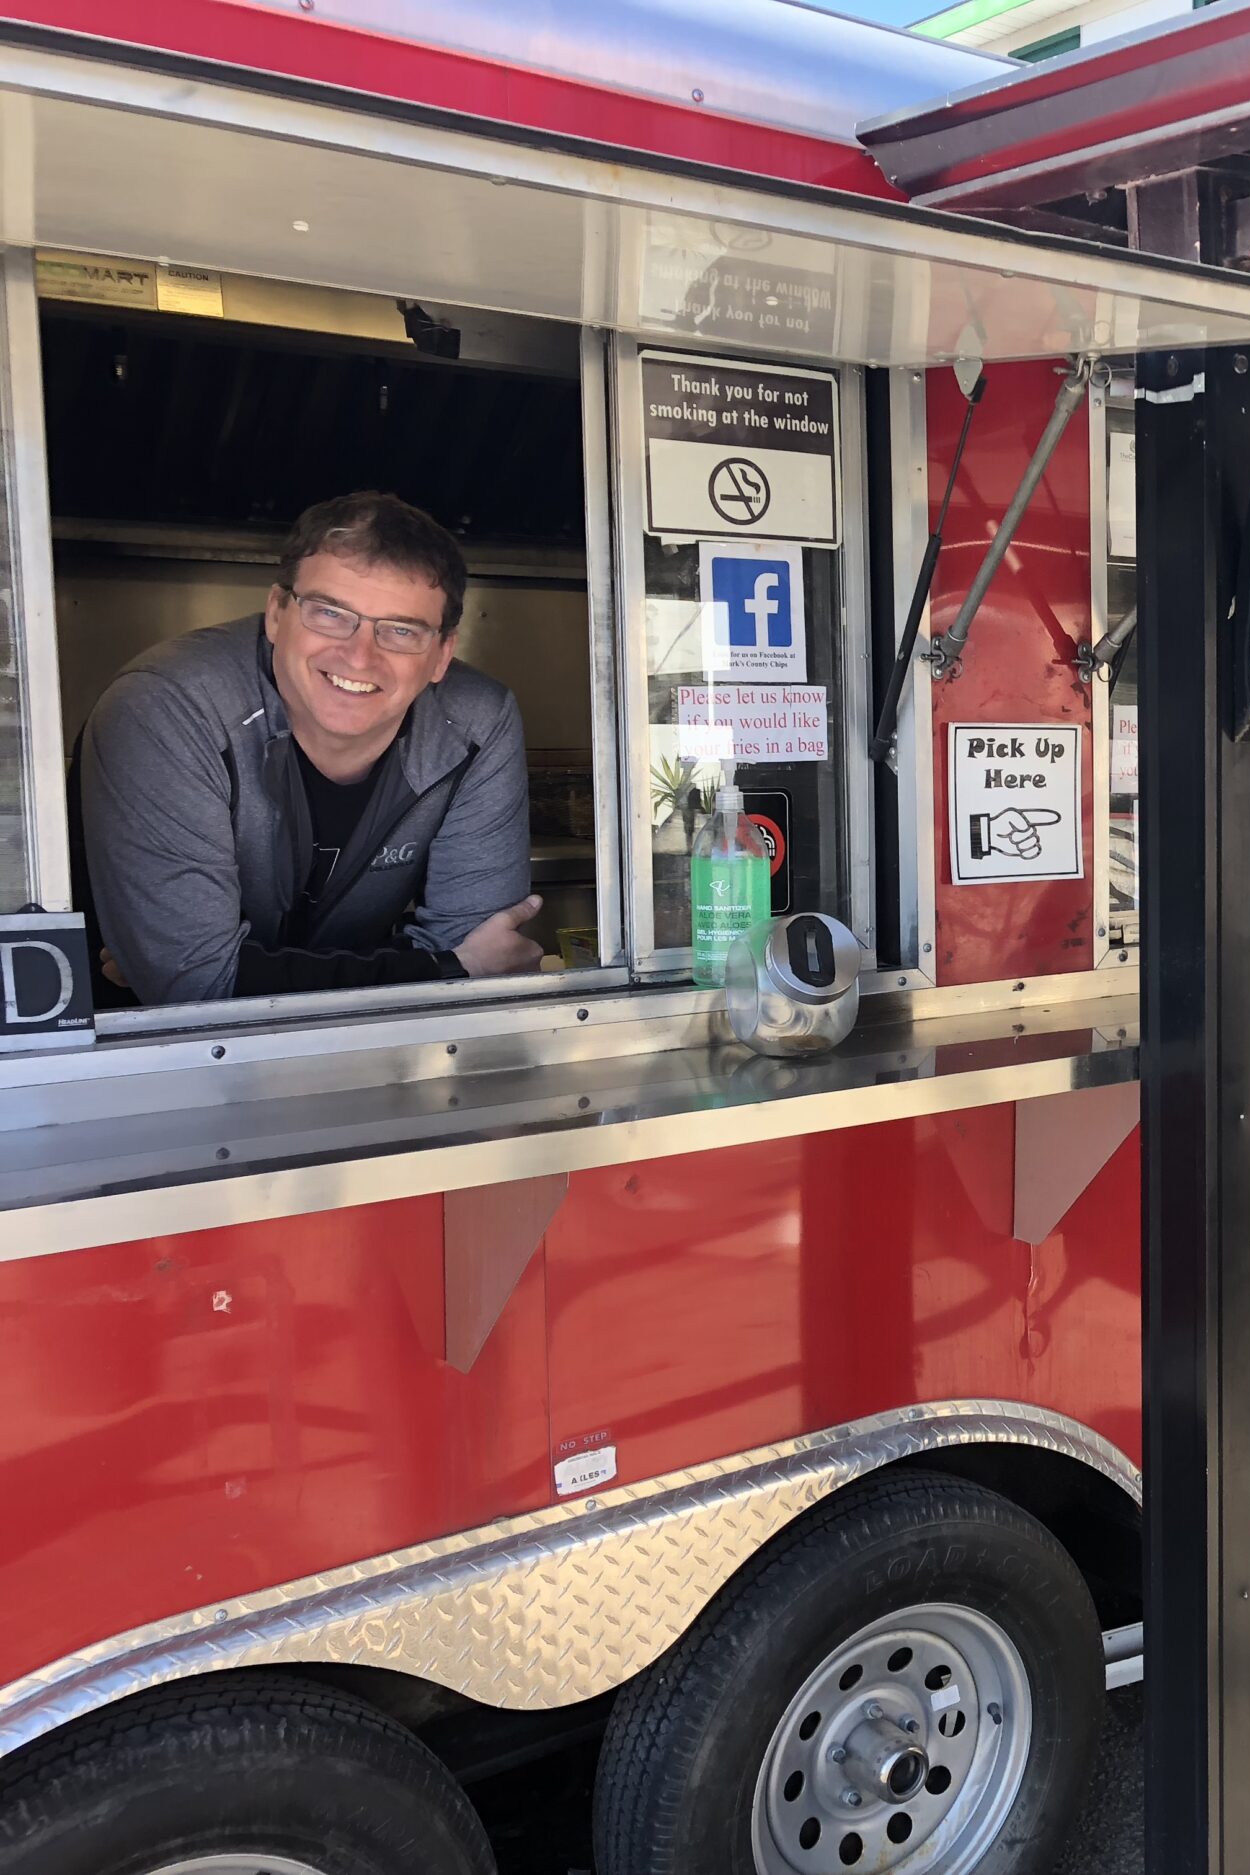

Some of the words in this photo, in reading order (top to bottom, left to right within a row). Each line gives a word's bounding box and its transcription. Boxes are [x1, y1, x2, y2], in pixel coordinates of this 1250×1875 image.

[671, 374, 719, 396] Thank
[725, 383, 752, 402] you
[757, 384, 780, 403] for
[785, 391, 809, 406] not
[650, 403, 717, 426] smoking
[722, 410, 738, 425] at
[743, 410, 769, 428] the
[774, 414, 829, 435] window
[746, 660, 768, 668] County
[770, 660, 788, 669] Chips
[759, 651, 788, 659] Facebook
[737, 689, 756, 705] let
[761, 692, 777, 705] us
[783, 688, 826, 705] know
[739, 714, 787, 729] would
[793, 713, 821, 729] like
[766, 738, 780, 754] in
[785, 741, 794, 753] a
[798, 737, 826, 756] bag
[967, 737, 1026, 759] Pick
[1035, 737, 1066, 764] Up
[984, 768, 1047, 789] Here
[726, 911, 752, 919] VERA
[560, 1442, 576, 1451] NO
[583, 1432, 607, 1445] STEP
